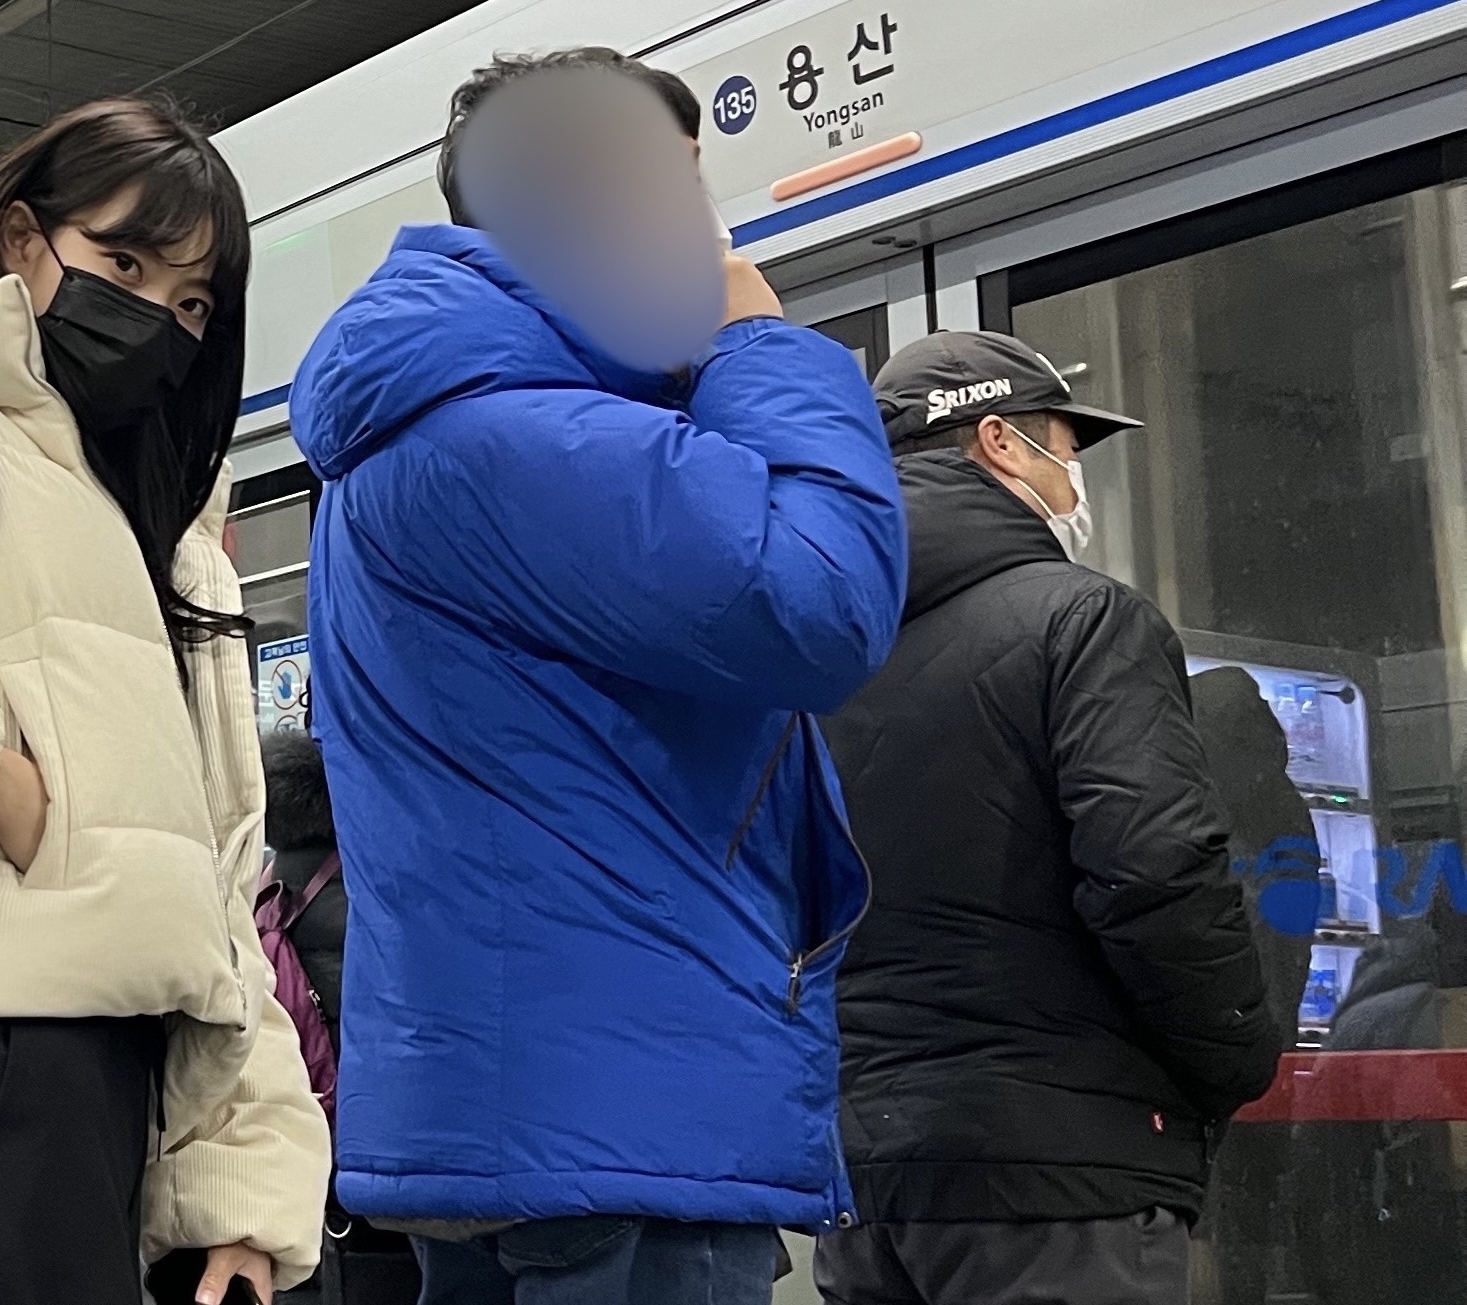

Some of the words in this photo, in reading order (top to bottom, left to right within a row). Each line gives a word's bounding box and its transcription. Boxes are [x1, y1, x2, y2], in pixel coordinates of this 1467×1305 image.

[713, 84, 756, 126] 135
[802, 91, 884, 133] Yongsan
[926, 378, 1013, 418] SRIXON
